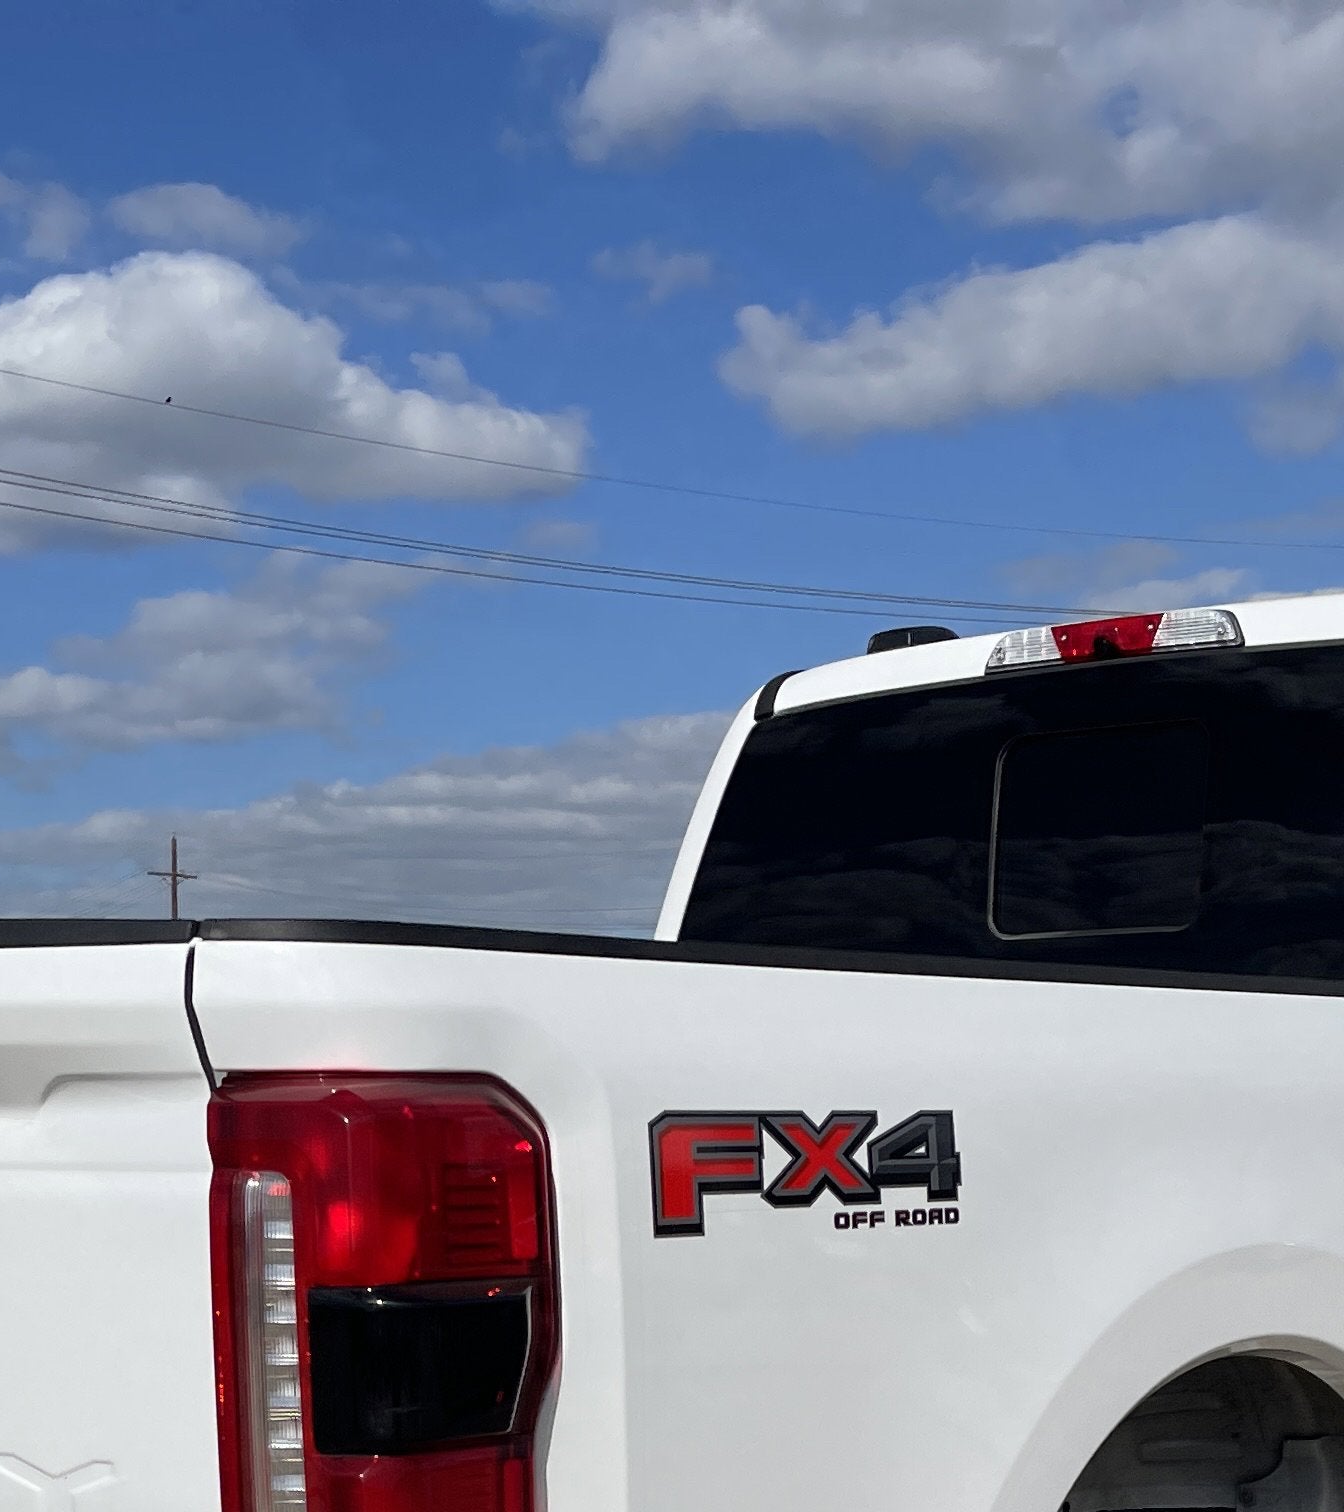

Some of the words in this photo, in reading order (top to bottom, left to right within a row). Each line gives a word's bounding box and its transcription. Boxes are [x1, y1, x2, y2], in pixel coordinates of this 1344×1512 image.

[648, 1109, 962, 1238] FX4
[834, 1211, 886, 1230] OFF
[895, 1207, 960, 1228] ROAD
